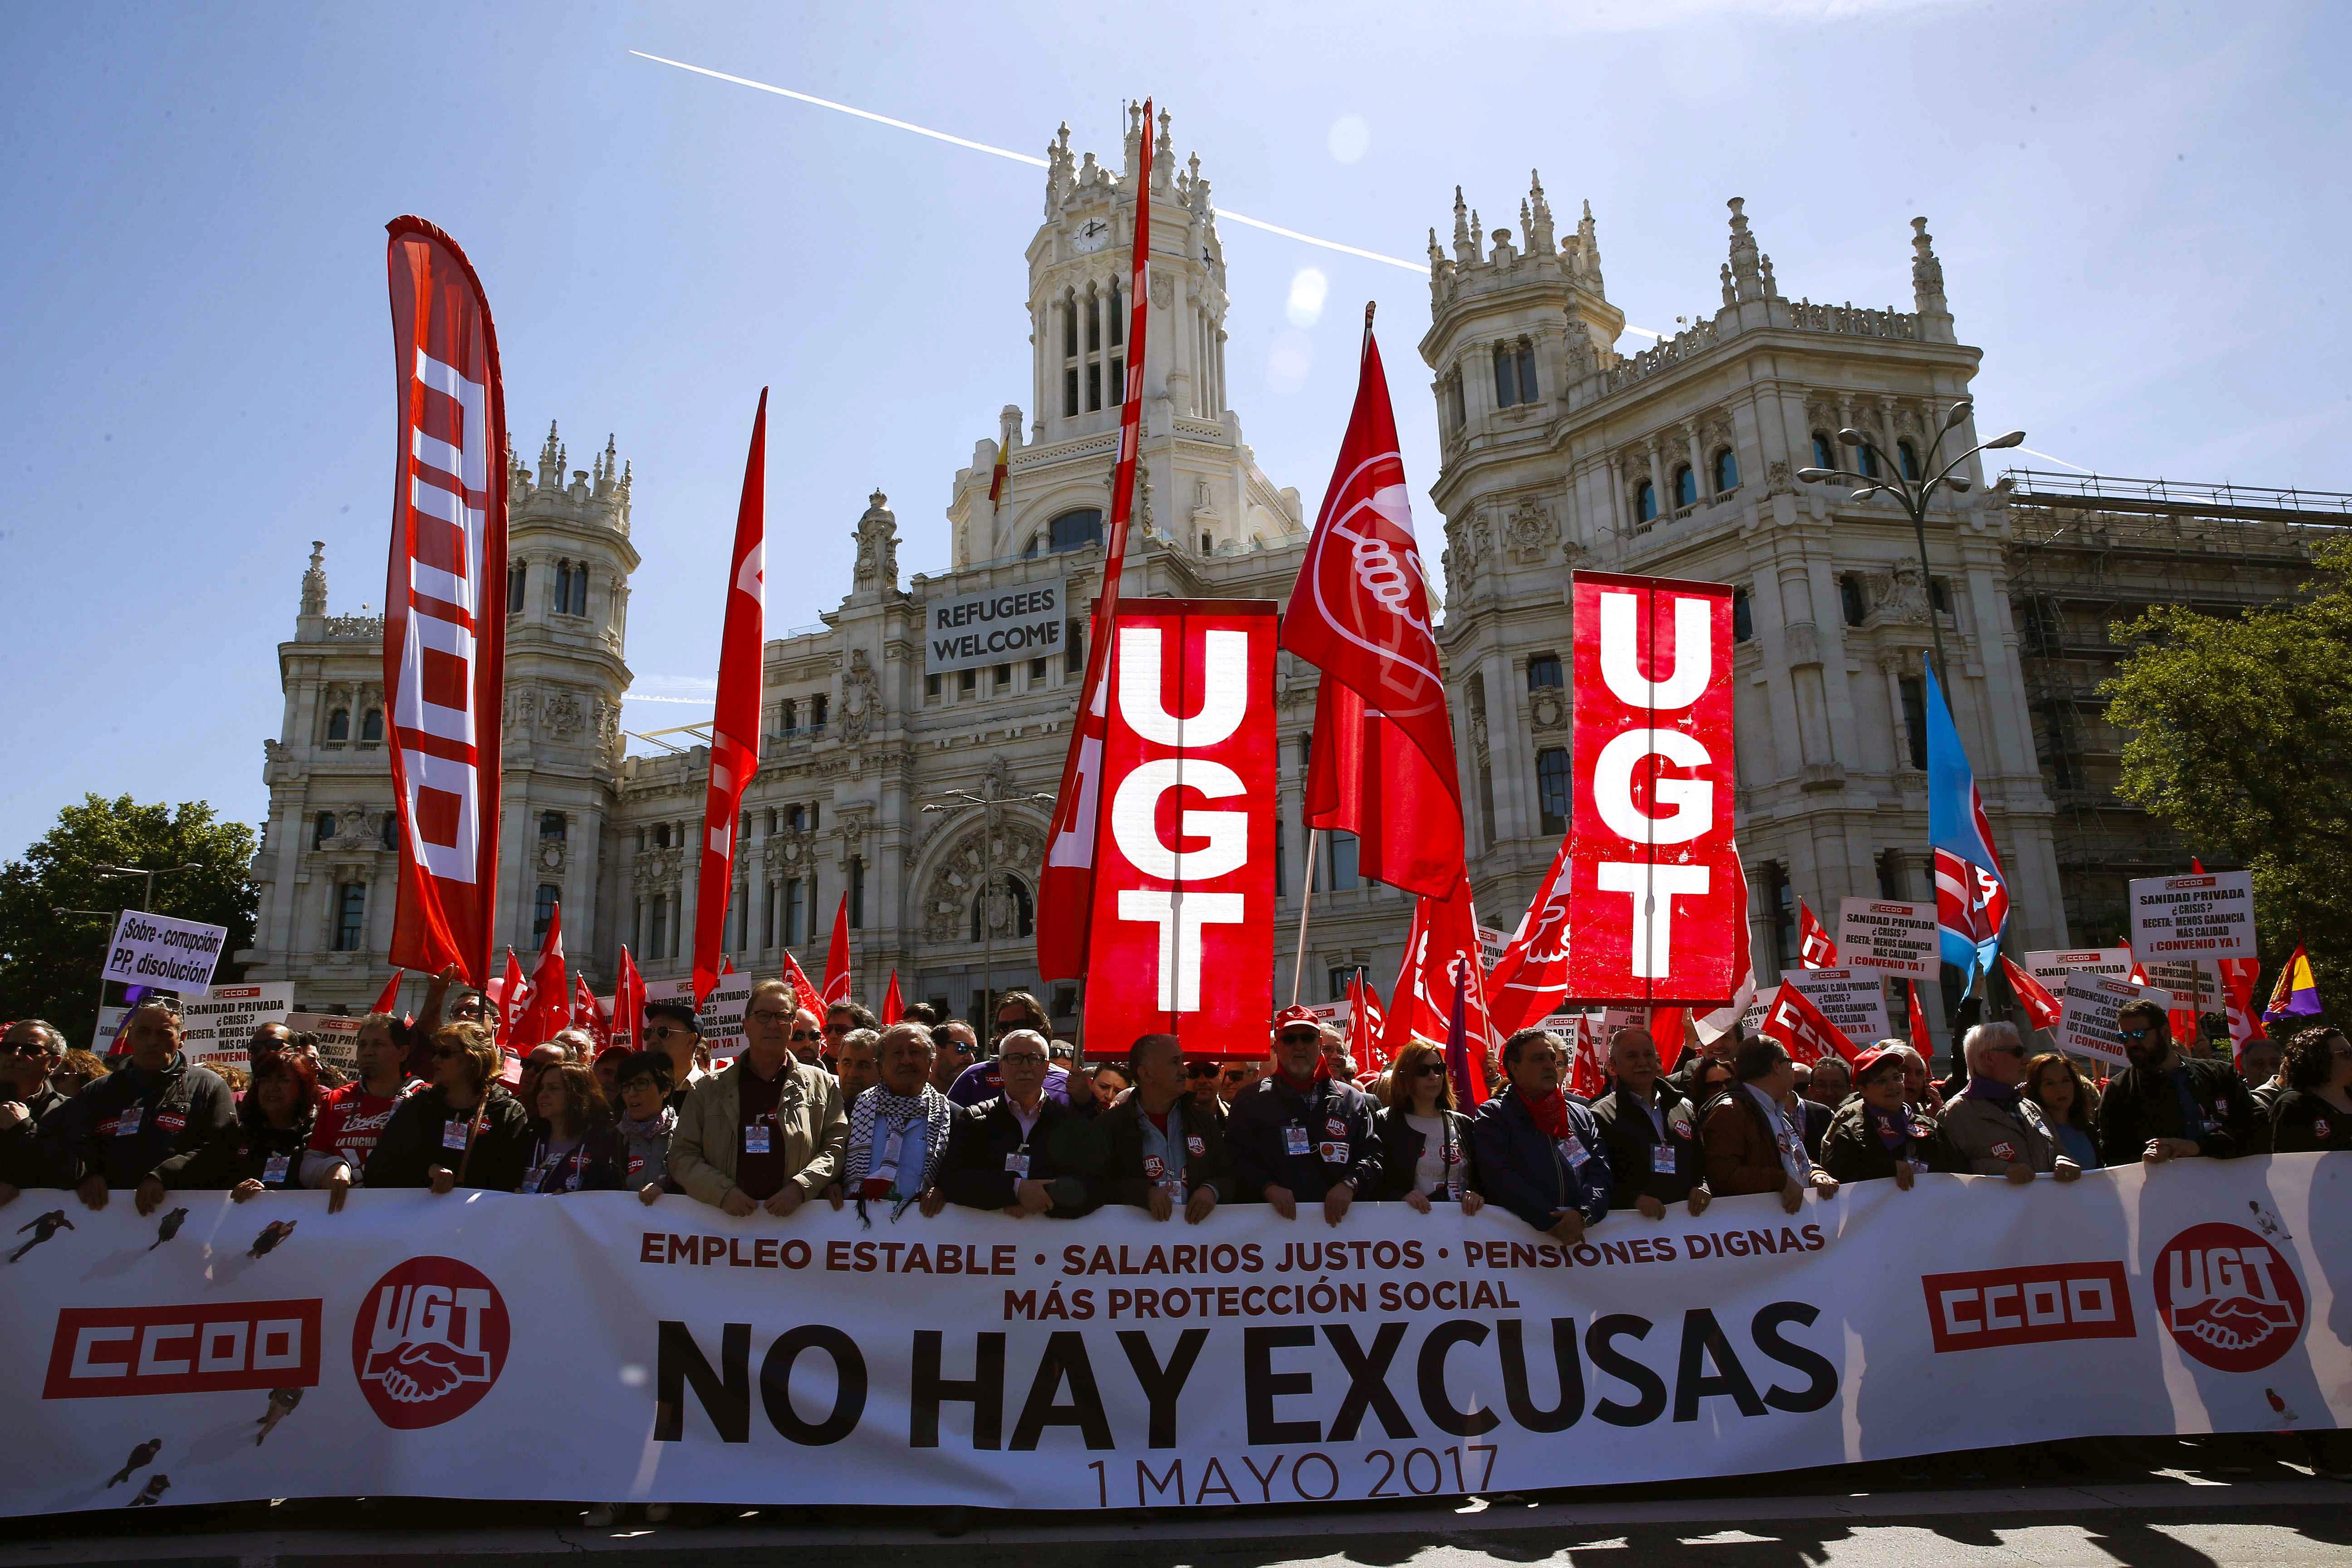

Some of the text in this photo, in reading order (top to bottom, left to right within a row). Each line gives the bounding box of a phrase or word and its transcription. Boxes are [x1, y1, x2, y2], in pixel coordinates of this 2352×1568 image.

[937, 588, 1055, 630] REFUGEES
[933, 620, 1059, 661] WELCOME
[1593, 592, 1713, 978] UGT
[1112, 628, 1248, 1012] UGT
[2141, 888, 2244, 905] SANIDAD PRIVADA
[1847, 913, 1935, 930] SANIDAD PRIVADA
[2143, 912, 2245, 928] RECETA: MENOS GANANCIA
[2176, 926, 2229, 938] MÁS CALIDAD
[1846, 934, 1932, 951] RECETA: MENOS GANANCIA
[2157, 939, 2215, 951] CONVENIO
[2219, 937, 2233, 947] YA
[1873, 946, 1917, 960] MÁS CALIDAD
[137, 953, 213, 984] disolución!
[1855, 956, 1905, 970] CONVENIO
[1907, 962, 1919, 971] YA
[2149, 966, 2158, 976] LOS
[2159, 966, 2192, 979] EMPRESARIO
[1849, 981, 1879, 991] PRIVADOS
[2107, 983, 2128, 993] CCOO
[2158, 979, 2192, 990] TRABAJADOR
[716, 990, 750, 1002] PRIVADOS
[2067, 986, 2112, 1005] RESIDENCIAS/
[186, 1000, 284, 1015] SANIDAD PRIVADA
[1822, 1003, 1877, 1014] MENOS GANANCIA
[719, 1014, 741, 1024] GANAN
[1839, 1014, 1866, 1024] CALIDAD
[2069, 1010, 2082, 1021] LOS
[187, 1029, 216, 1039] RECETA:
[219, 1028, 244, 1038] MENOS
[722, 1024, 745, 1036] PAGAN
[1858, 1024, 1871, 1033] YA
[2067, 1021, 2078, 1032] LOS
[219, 1039, 235, 1050] MÁS
[721, 1037, 735, 1048] YA
[2075, 1035, 2123, 1056] CONVENIO
[158, 1116, 186, 1126] CCOO
[1328, 1118, 1345, 1132] UGT
[1676, 1121, 1692, 1134] UGT
[335, 1137, 378, 1147] LA LUCHA
[1188, 1137, 1202, 1147] UGT
[1991, 1142, 2011, 1156] UGT
[1143, 1157, 1161, 1169] UGT
[639, 1224, 1826, 1275] EMPLEO ESTABLE SALARIOS JUSTOS PENSIONES DIGNAS
[2169, 1247, 2279, 1306] UGT
[1004, 1275, 1520, 1321] MÁS PROTECCIÓN SOCIAL
[1940, 1279, 2116, 1335] CCOO
[371, 1284, 491, 1355] UGT
[69, 1318, 302, 1378] CCOO
[652, 1300, 1839, 1451] NO HAY EXCUSAS
[1088, 1444, 1499, 1508] 1 MAYO 2017
